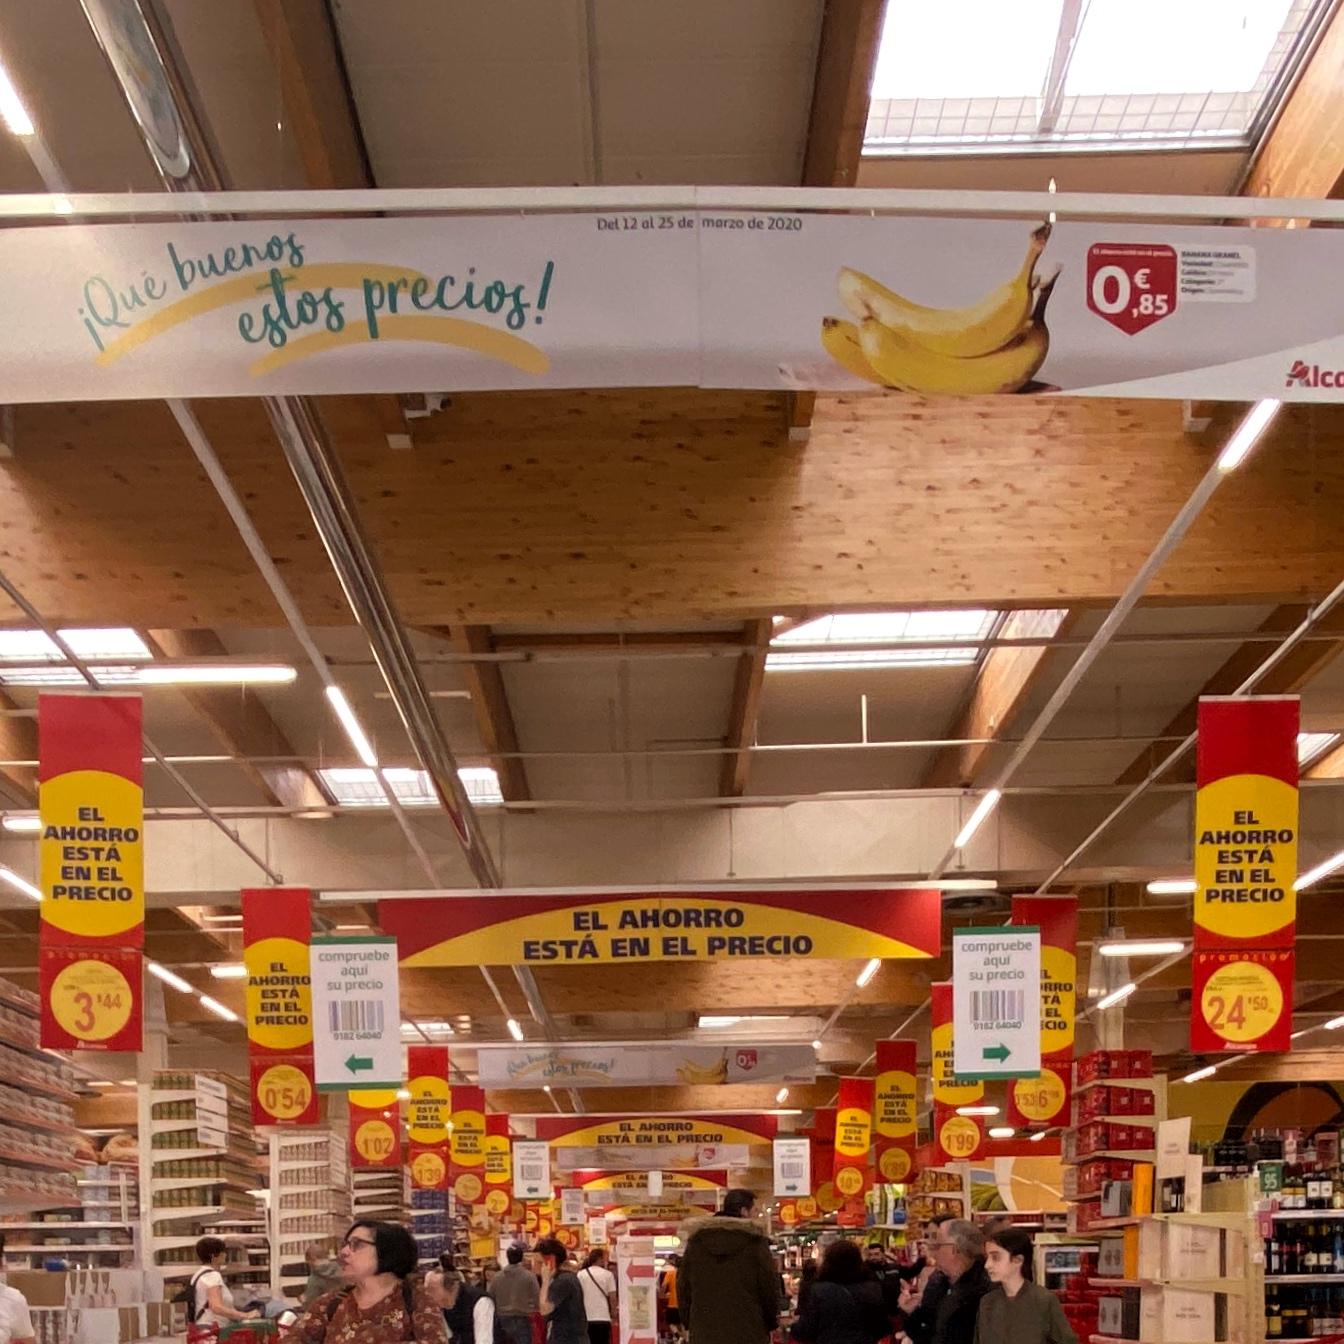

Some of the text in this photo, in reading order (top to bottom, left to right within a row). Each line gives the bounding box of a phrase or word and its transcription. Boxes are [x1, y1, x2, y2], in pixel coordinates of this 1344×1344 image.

[597, 216, 802, 231] Del 12 al 25 de marzo de 2020
[167, 232, 304, 290] buenos
[239, 261, 554, 348] estos precios!
[78, 807, 105, 822] EL
[1233, 810, 1260, 825] EL
[43, 825, 139, 843] AHORRO
[1199, 829, 1294, 845] AHORRO
[62, 843, 122, 862] ESTÁ
[1217, 845, 1274, 864] ESTÁ
[61, 865, 124, 882] EN EL
[1215, 868, 1276, 884] EN EL
[52, 885, 133, 902] PRECIO
[1205, 888, 1285, 903] PRECIO
[573, 907, 744, 931] EL AHORRO
[523, 934, 813, 960] ESTÁ EN EL PRECIO
[961, 940, 1033, 954] compruebe
[318, 950, 390, 964] compruebe
[983, 955, 1011, 968] aquí
[270, 962, 288, 973] EL
[340, 965, 369, 979] aquí
[248, 975, 312, 986] AHORRO
[969, 970, 1025, 982] su precio
[261, 986, 301, 999] ESTÁ
[327, 979, 384, 993] su precio
[260, 1001, 302, 1013] EN EL
[255, 1014, 309, 1026] PRECIO
[619, 1122, 694, 1132] EL AHORRO
[598, 1132, 723, 1144] ESTÁ EN EL PRECIO
